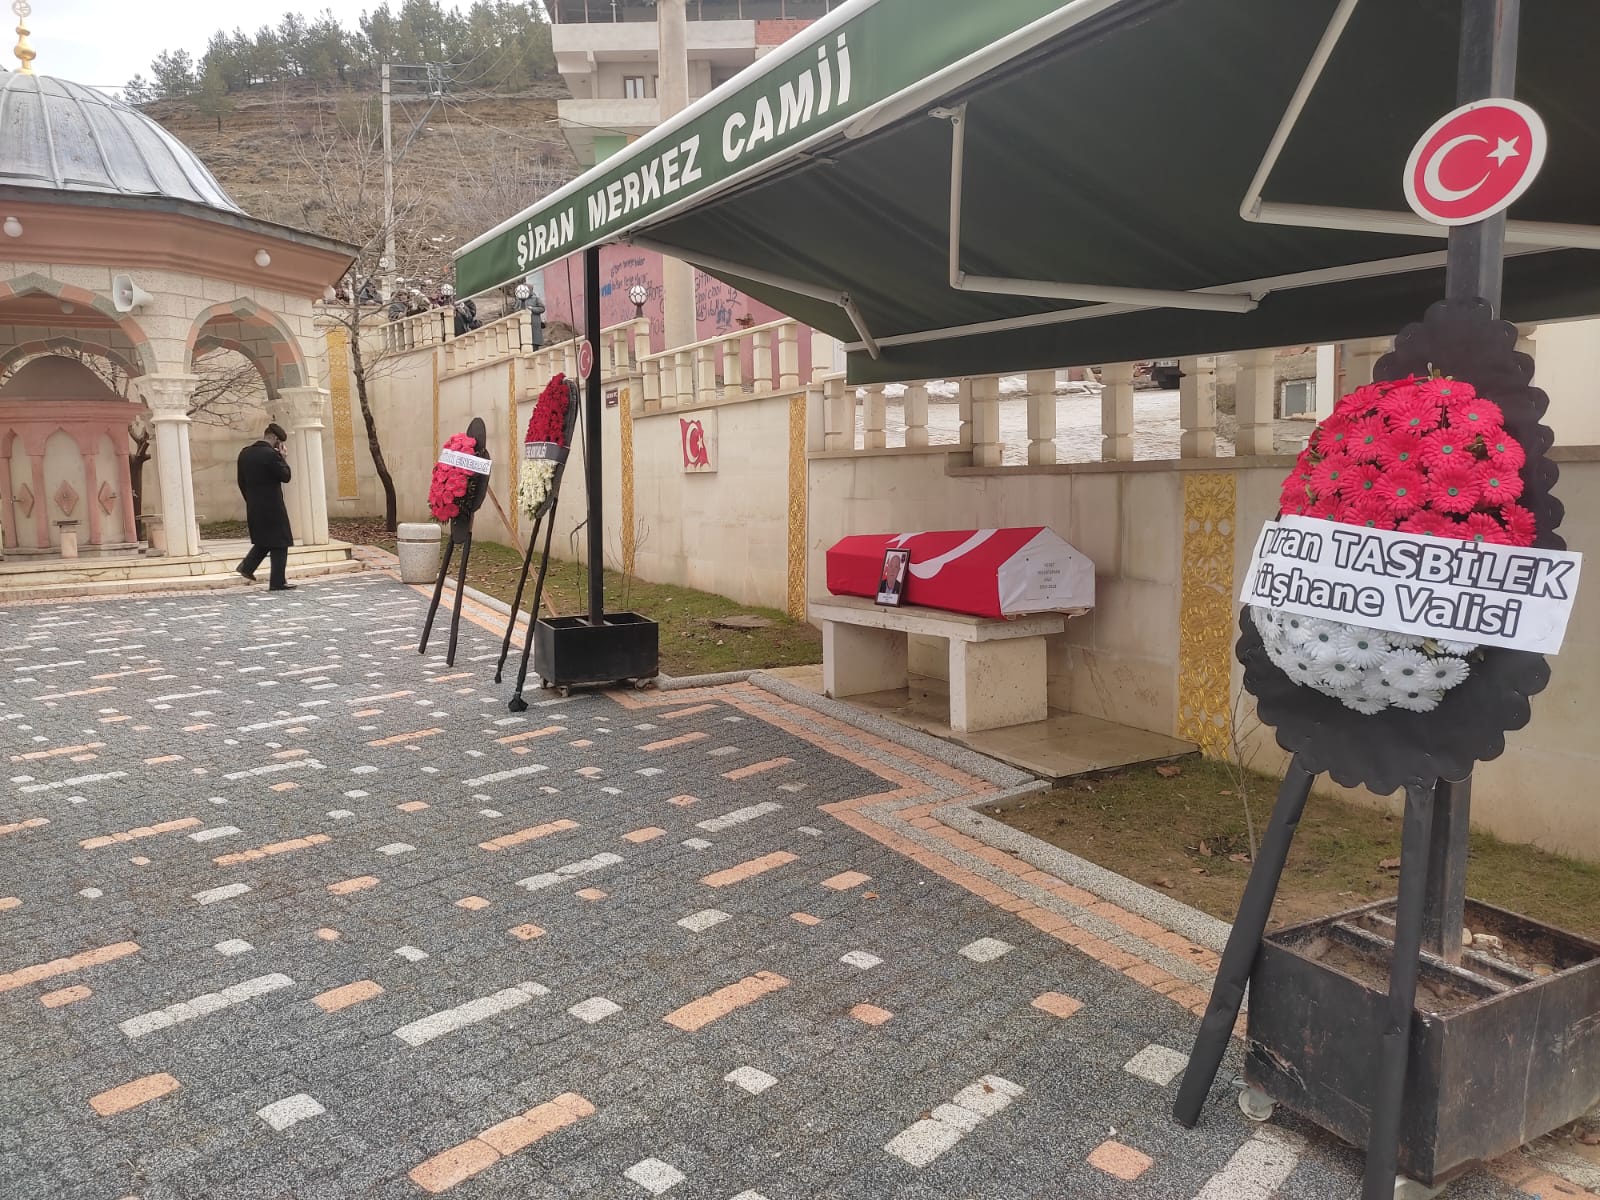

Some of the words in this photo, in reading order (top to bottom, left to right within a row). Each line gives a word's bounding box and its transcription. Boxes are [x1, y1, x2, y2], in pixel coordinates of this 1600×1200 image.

[517, 207, 575, 272] ŞİRAN
[587, 134, 702, 232] MERKEZ
[722, 32, 851, 163] CAMİİ
[1252, 562, 1385, 617] üşhane
[1395, 584, 1522, 638] Valisi
